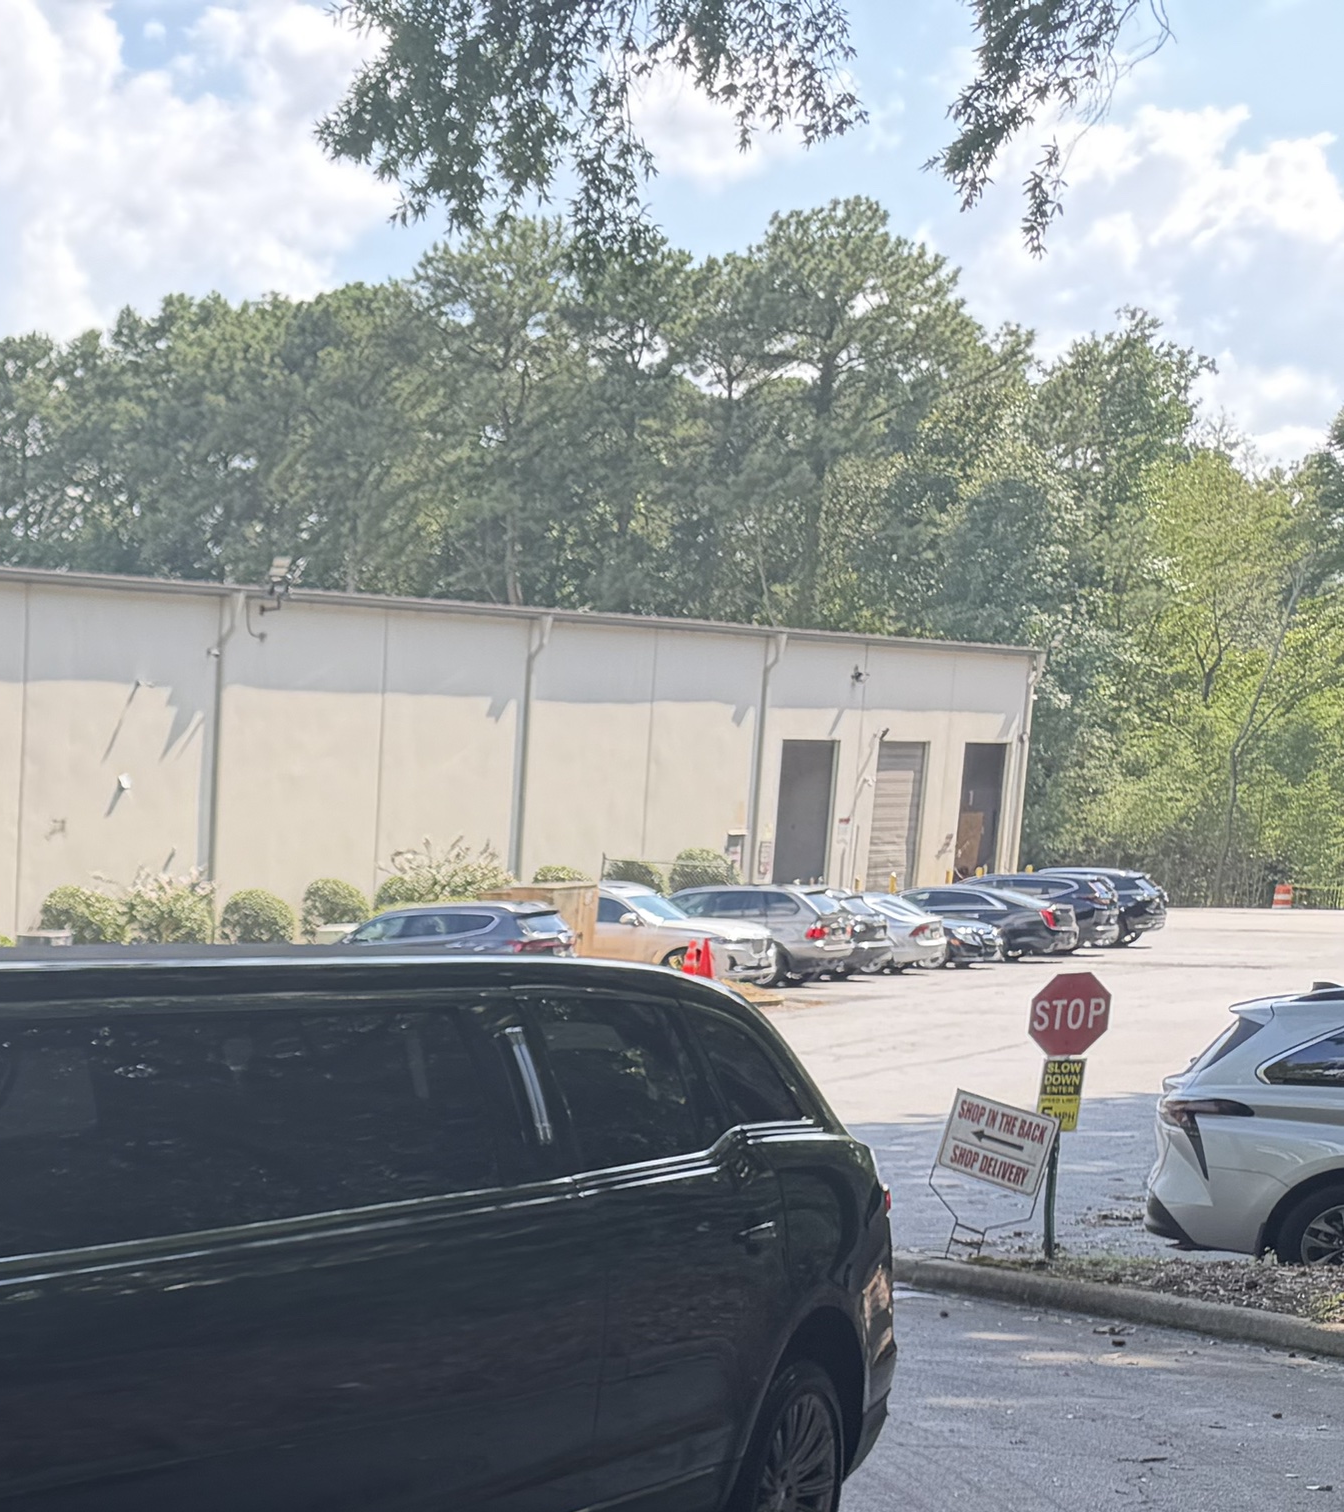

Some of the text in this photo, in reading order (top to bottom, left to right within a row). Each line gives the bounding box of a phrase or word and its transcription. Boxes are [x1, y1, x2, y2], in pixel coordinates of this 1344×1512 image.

[1033, 998, 1106, 1031] STOP
[1046, 1062, 1082, 1074] SLOW
[1044, 1074, 1080, 1085] DOWN
[1046, 1085, 1075, 1094] ENTER
[957, 1099, 1048, 1145] SHOP IN THE BACK
[950, 1144, 1029, 1187] SHOP DELIVERY
